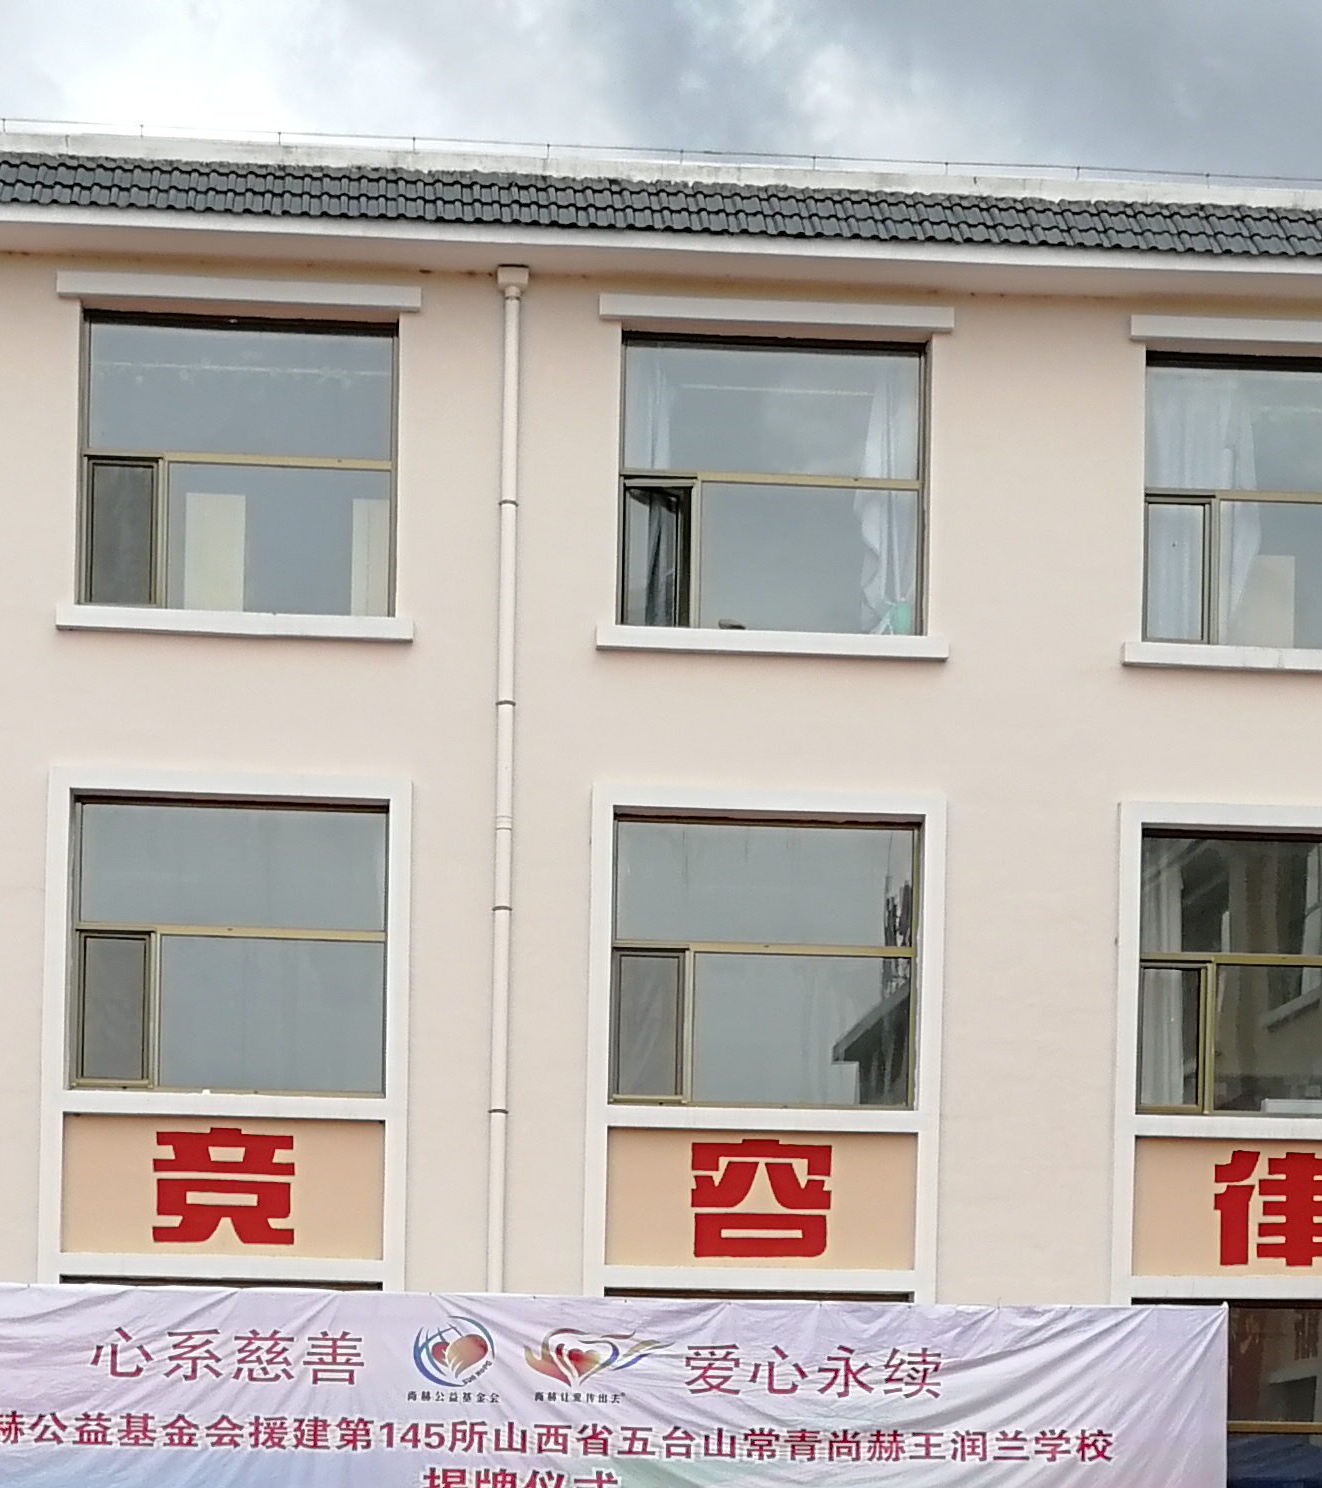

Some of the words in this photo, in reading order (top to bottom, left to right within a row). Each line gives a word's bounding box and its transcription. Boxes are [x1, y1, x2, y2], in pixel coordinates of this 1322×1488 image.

[151, 1127, 296, 1246] 竞
[690, 1138, 833, 1259] 容
[89, 1325, 366, 1386] 心系慈善
[684, 1343, 944, 1400] 爱心永续
[407, 1390, 501, 1404] 尚赫公益基金会
